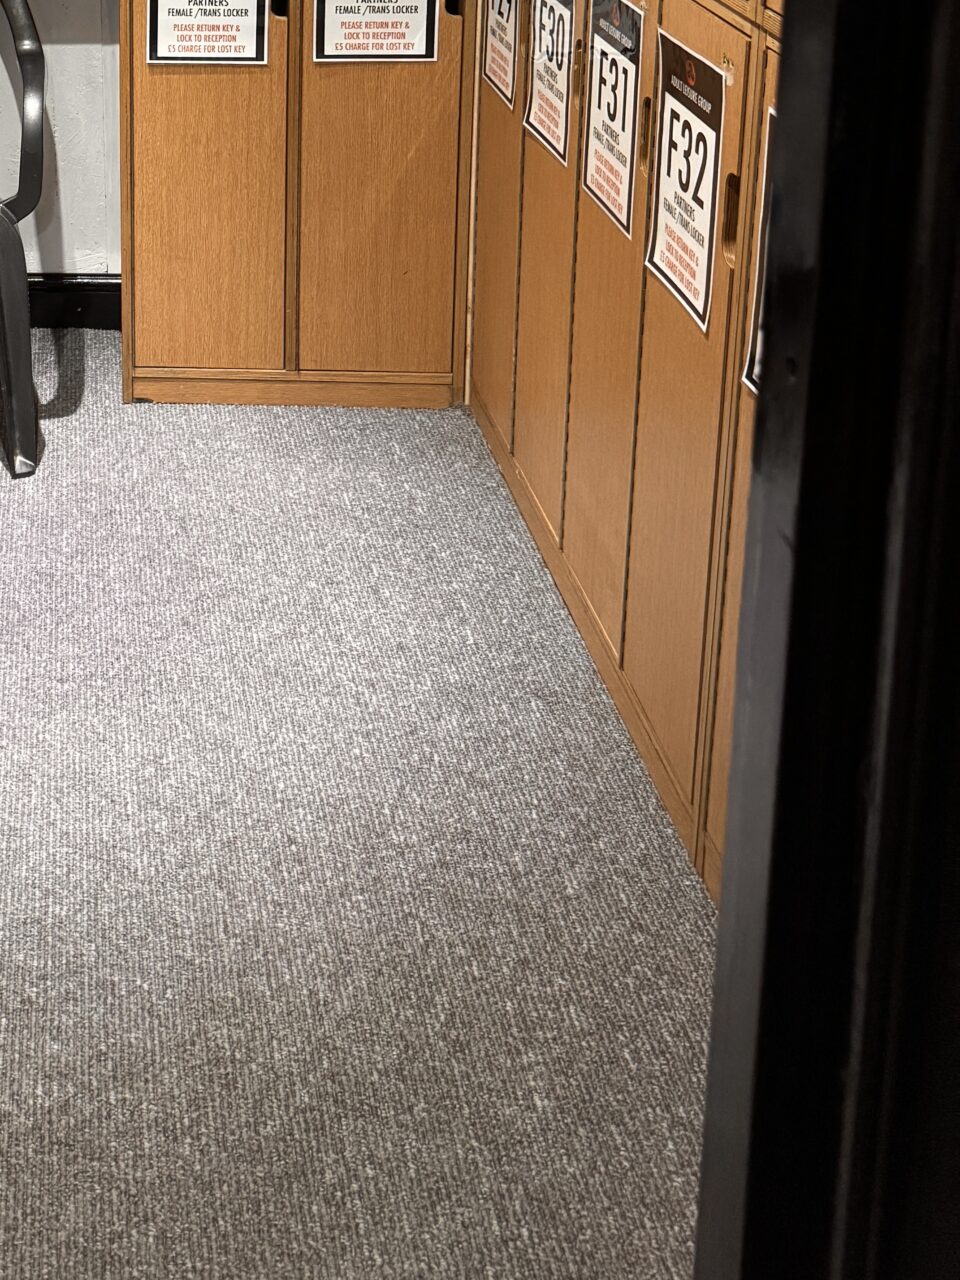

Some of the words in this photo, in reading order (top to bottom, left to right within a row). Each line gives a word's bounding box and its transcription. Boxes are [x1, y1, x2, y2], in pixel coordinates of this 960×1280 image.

[167, 7, 193, 17] FEMALE
[194, 7, 222, 19] /TRANS
[222, 8, 249, 18] LOCKER
[335, 5, 362, 15] FEMALE
[362, 5, 391, 16] /TRANS
[392, 4, 419, 14] LOCKER
[173, 23, 195, 32] PLEASE
[196, 23, 221, 32] RETURN
[222, 24, 234, 32] KEY
[235, 24, 241, 33] &
[340, 20, 363, 30] PLEASE
[364, 21, 390, 30] RETURN
[390, 21, 404, 30] KEY
[404, 21, 410, 30] &
[176, 34, 193, 43] LOCK
[193, 34, 203, 43] TO
[203, 34, 237, 43] RECEPTION
[343, 31, 361, 40] LOCK
[361, 31, 371, 40] TO
[371, 31, 406, 40] RECEPTION
[167, 44, 176, 53] £5
[177, 44, 202, 54] CHARGE
[203, 44, 216, 54] FOR
[217, 44, 232, 54] LOST
[233, 44, 246, 54] KEY
[334, 42, 344, 51] £5
[344, 42, 370, 51] CHARGE
[371, 42, 385, 51] FOR
[385, 42, 402, 51] LOST
[402, 42, 415, 51] KEY
[597, 45, 629, 133] F31
[666, 107, 708, 210] F32
[673, 191, 696, 223] PARTNERS
